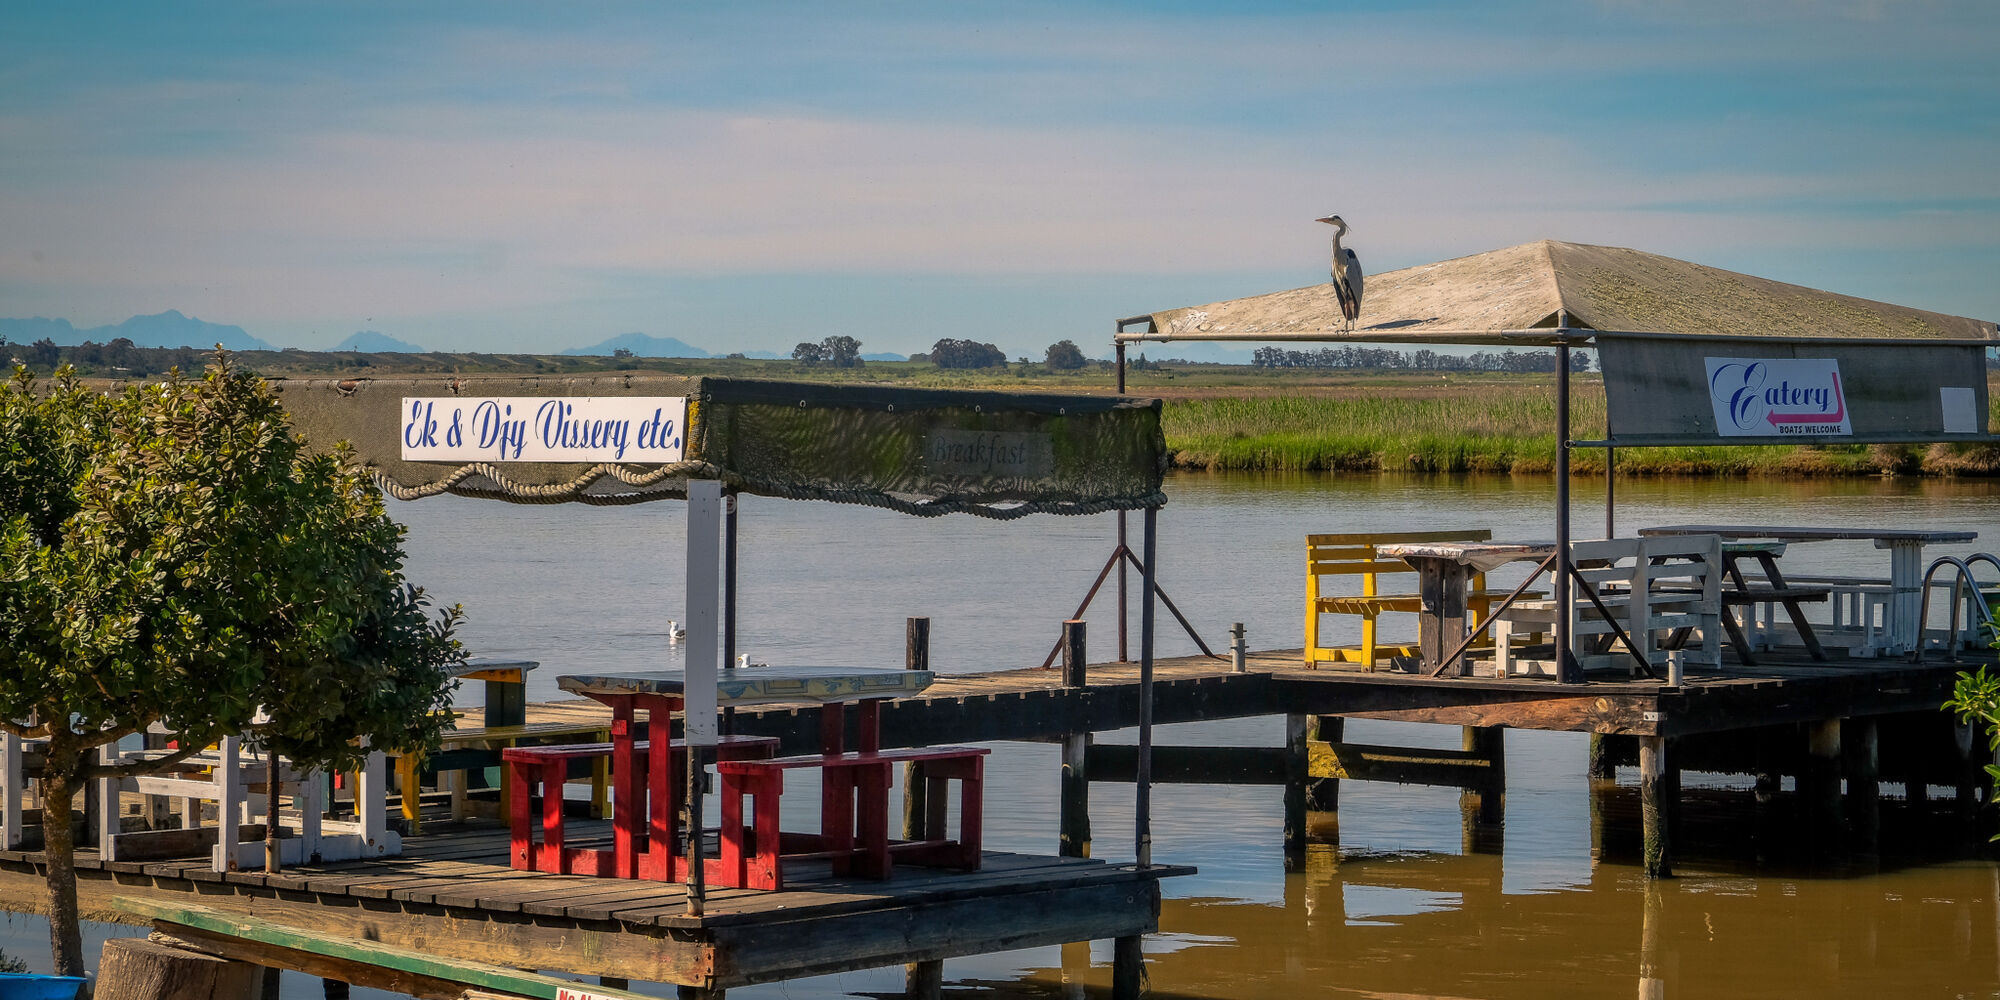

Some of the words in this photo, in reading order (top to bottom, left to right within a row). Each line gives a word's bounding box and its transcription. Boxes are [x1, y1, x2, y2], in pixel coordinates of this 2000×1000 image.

[1712, 362, 1832, 430] Eatery
[404, 400, 439, 449] Ek
[446, 407, 463, 449] &
[472, 400, 527, 460] Djy
[535, 400, 631, 460] Vissery
[637, 408, 681, 449] etc.
[935, 433, 1026, 474] Breakfast
[1779, 425, 1803, 434] BOATS
[1804, 425, 1841, 434] WELCOME
